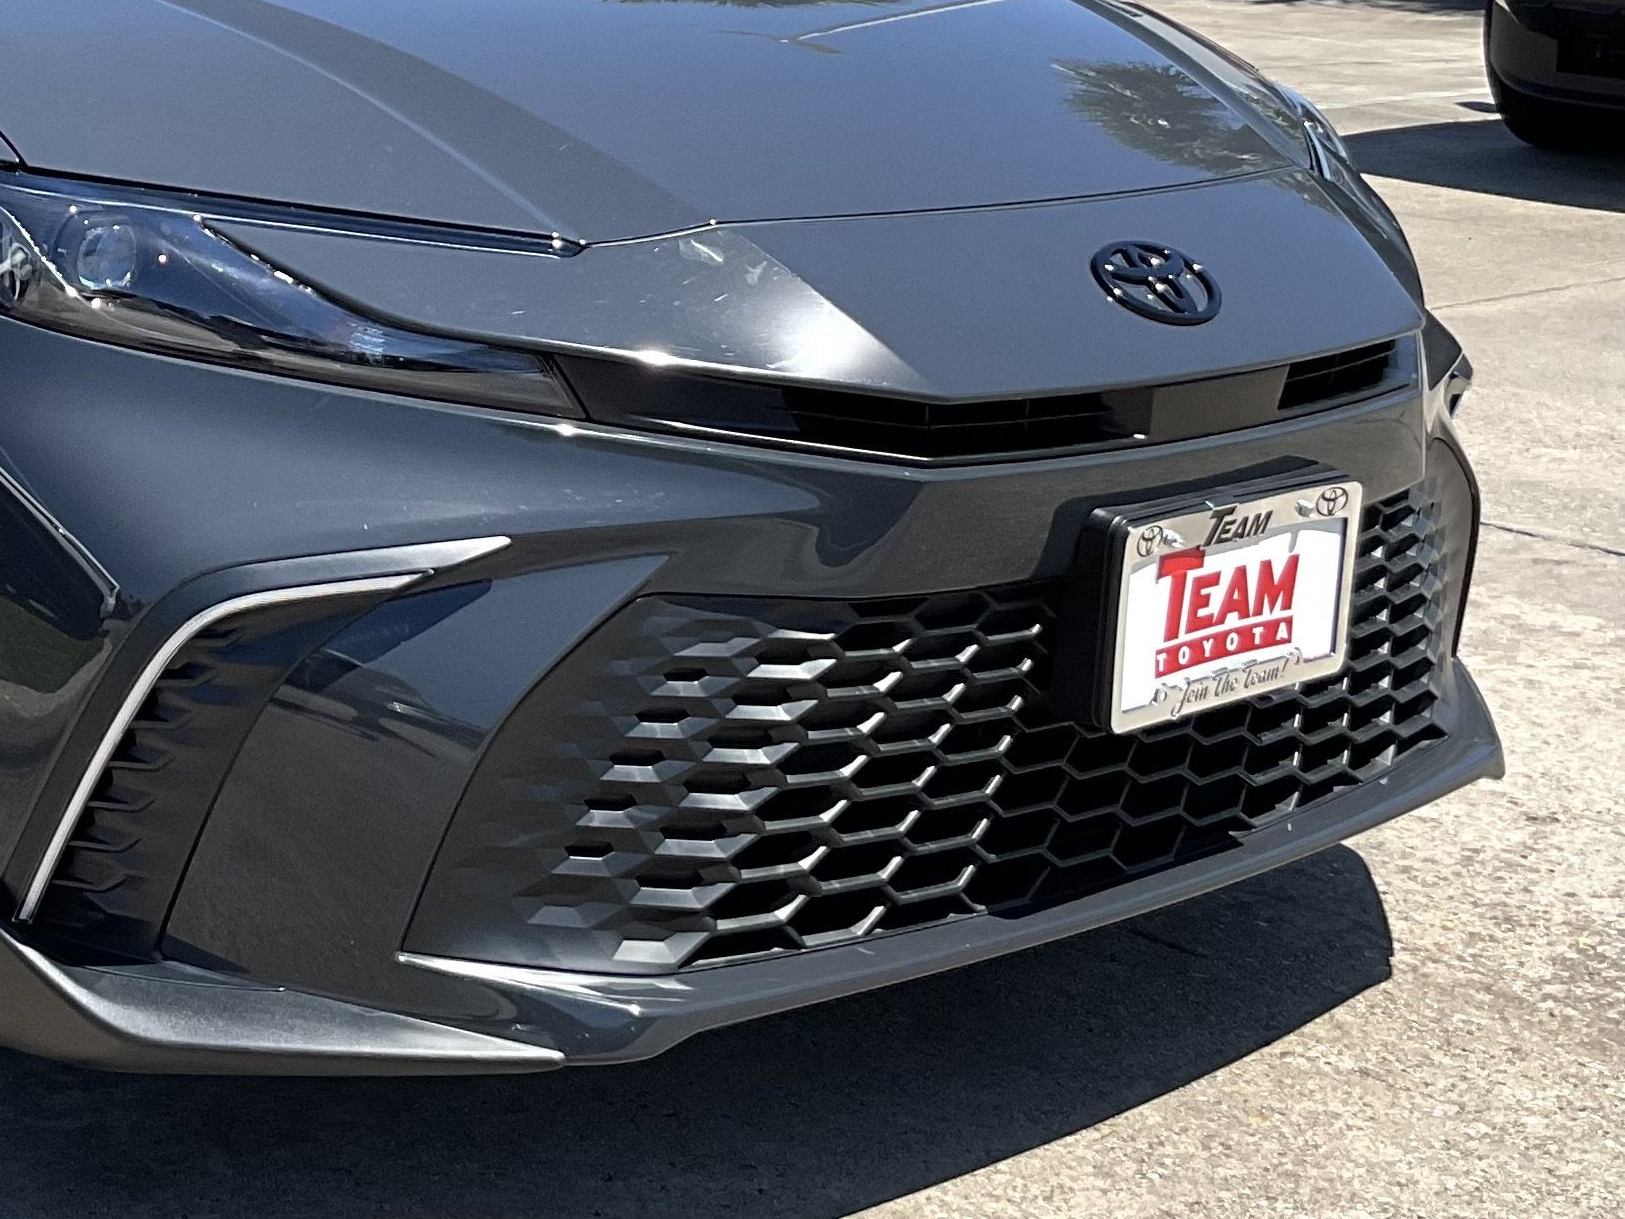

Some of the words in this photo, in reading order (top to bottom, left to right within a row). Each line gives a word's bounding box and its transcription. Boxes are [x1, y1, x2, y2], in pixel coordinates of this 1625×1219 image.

[1201, 505, 1274, 548] TEAM
[1157, 547, 1300, 643] TEAM
[1156, 621, 1289, 672] TOYOTA
[1170, 679, 1210, 719] Join
[1213, 668, 1239, 697] The
[1241, 657, 1290, 687] Team!
